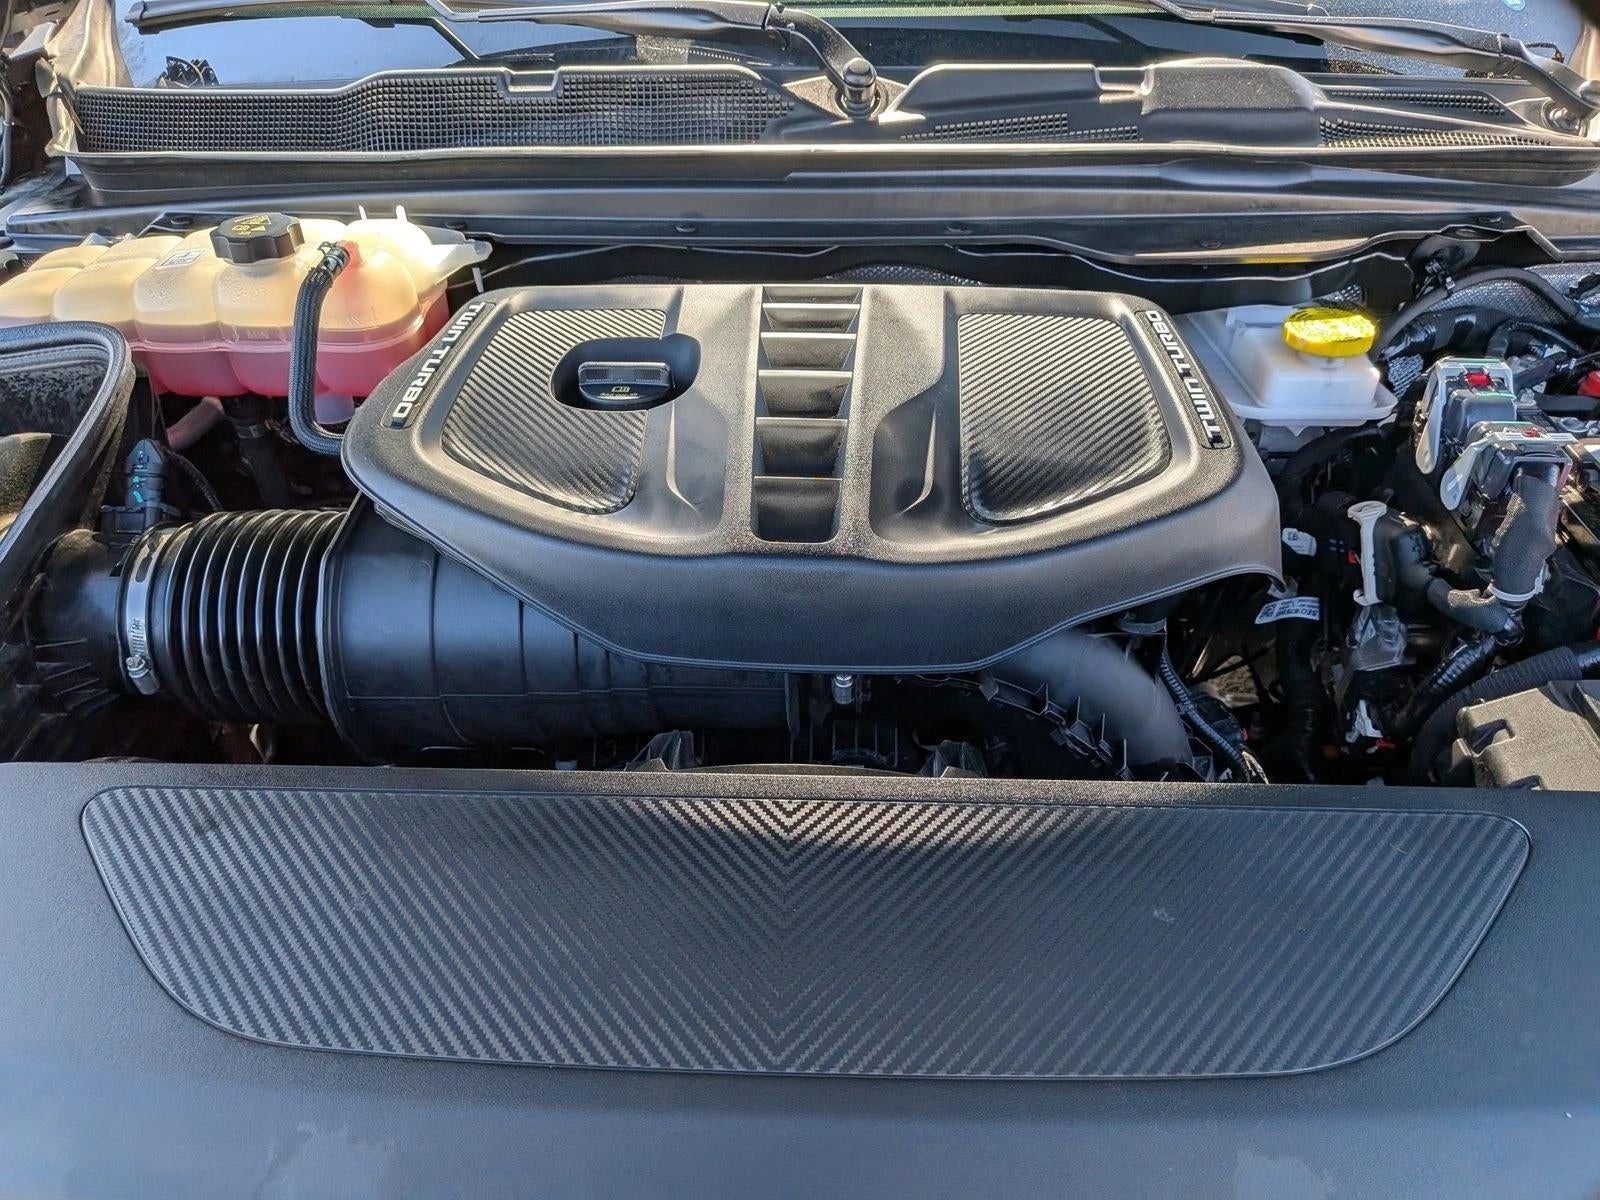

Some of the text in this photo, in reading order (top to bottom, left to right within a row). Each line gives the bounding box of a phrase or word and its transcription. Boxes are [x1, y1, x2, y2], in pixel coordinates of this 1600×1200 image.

[247, 329, 270, 340] MIN
[392, 301, 486, 418] TWIN TURBO
[1145, 310, 1221, 439] TWIN TURBO
